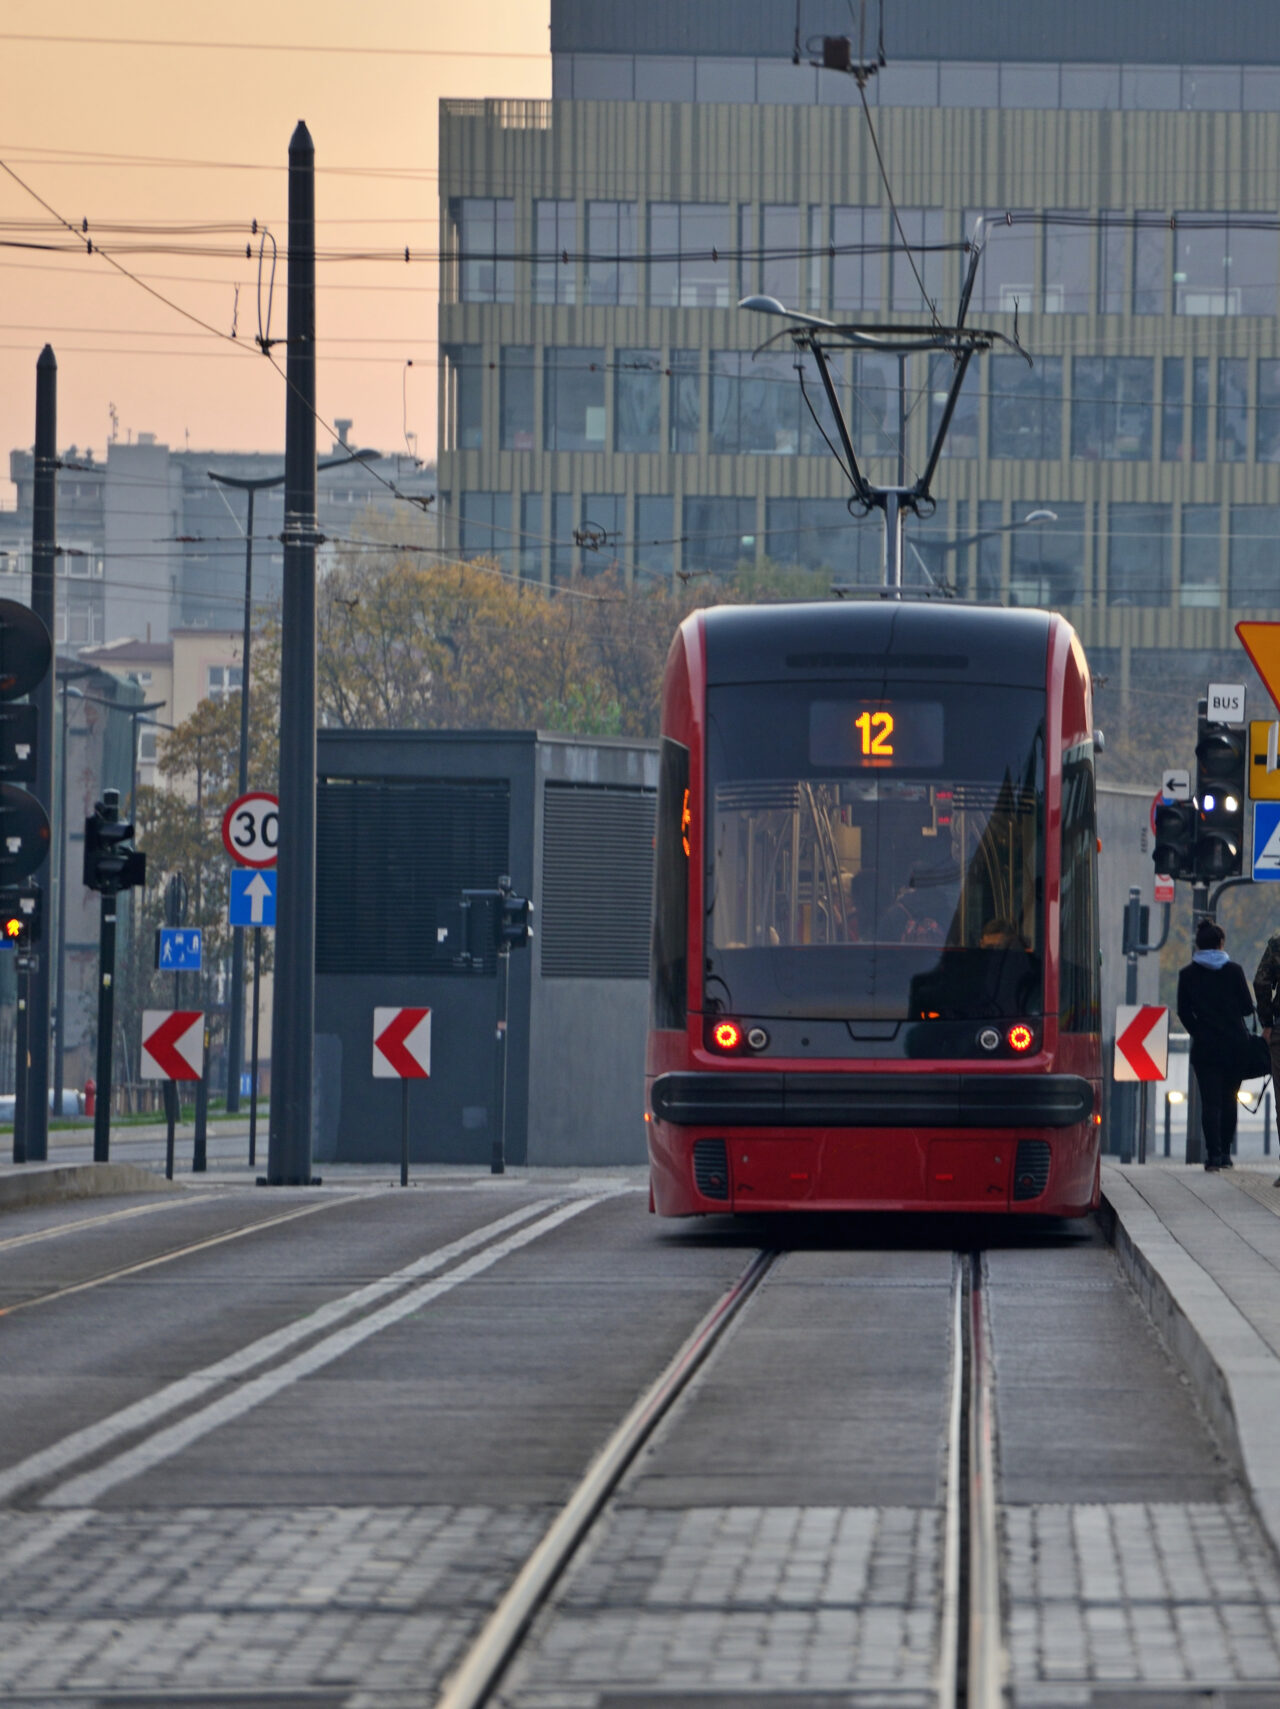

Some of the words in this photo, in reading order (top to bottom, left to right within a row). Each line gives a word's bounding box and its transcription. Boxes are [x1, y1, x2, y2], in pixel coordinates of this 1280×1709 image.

[1212, 696, 1240, 710] BUS
[854, 711, 894, 756] 12
[234, 811, 278, 848] 30
